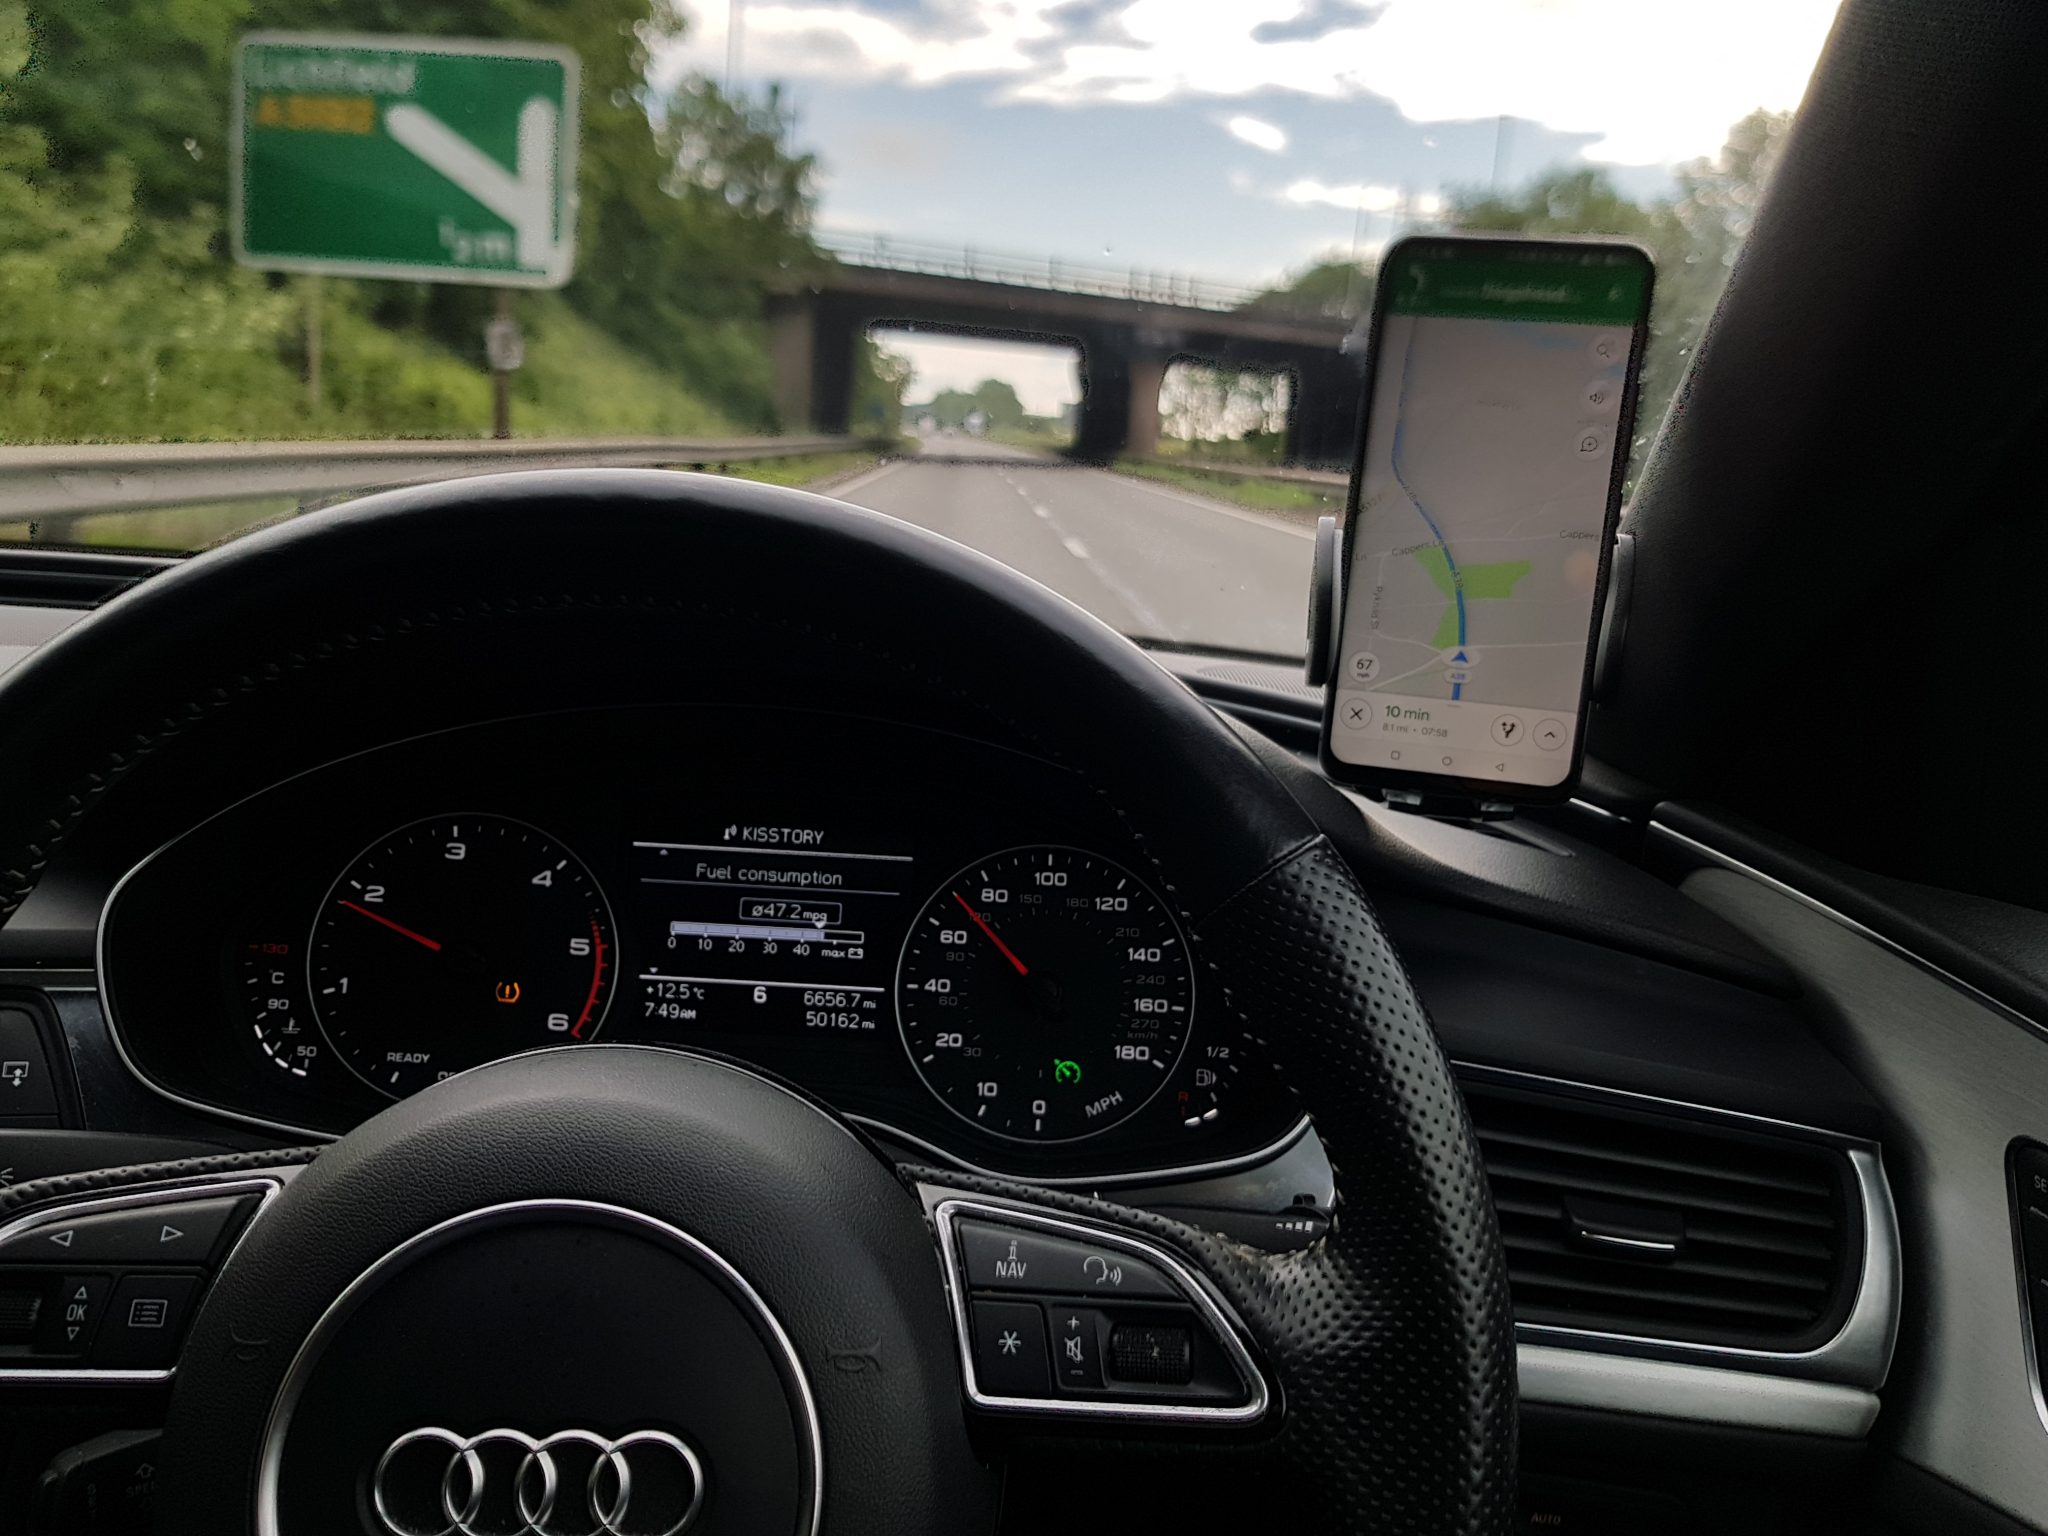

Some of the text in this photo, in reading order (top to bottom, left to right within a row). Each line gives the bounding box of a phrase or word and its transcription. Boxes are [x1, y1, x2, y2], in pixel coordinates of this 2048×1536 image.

[1356, 658, 1373, 671] 67
[1385, 705, 1430, 721] 10 min
[1420, 727, 1448, 738] 07:58
[743, 826, 824, 845] KISSTORY
[444, 843, 466, 860] 3
[531, 870, 553, 887] 4
[696, 863, 842, 886] Fuel consumption
[1034, 872, 1067, 887] 100
[364, 885, 385, 903] 2
[980, 888, 1009, 903] 80
[1095, 897, 1128, 911] 120
[940, 930, 967, 944] 60
[1115, 927, 1140, 938] 210
[569, 938, 590, 956] 5
[667, 938, 677, 949] 0
[698, 939, 713, 951] 10
[728, 941, 745, 953] 20
[763, 943, 777, 954] 30
[793, 944, 810, 956] 40
[822, 949, 846, 959] max
[1127, 948, 1160, 962] 140
[338, 977, 348, 994] 1
[923, 978, 951, 992] 40
[1136, 975, 1166, 986] 240
[753, 986, 767, 1003] 6
[267, 998, 289, 1010] 90
[863, 1000, 876, 1009] mi
[1133, 999, 1168, 1013] 160
[548, 1013, 569, 1031] 6
[805, 1012, 875, 1029] 50162 mi
[1131, 1019, 1159, 1029] 270
[935, 1033, 962, 1047] 20
[296, 1045, 317, 1058] 50
[386, 1051, 430, 1064] READY
[1114, 1045, 1149, 1060] 180
[1206, 1046, 1230, 1059] 1/2
[976, 1082, 998, 1097] 10
[1032, 1100, 1046, 1115] 0
[1084, 1091, 1124, 1119] MPH
[2034, 1174, 2048, 1194] SE
[995, 1260, 1027, 1279] NAV
[66, 1304, 88, 1322] OK
[1530, 1512, 1562, 1526] AUTO
